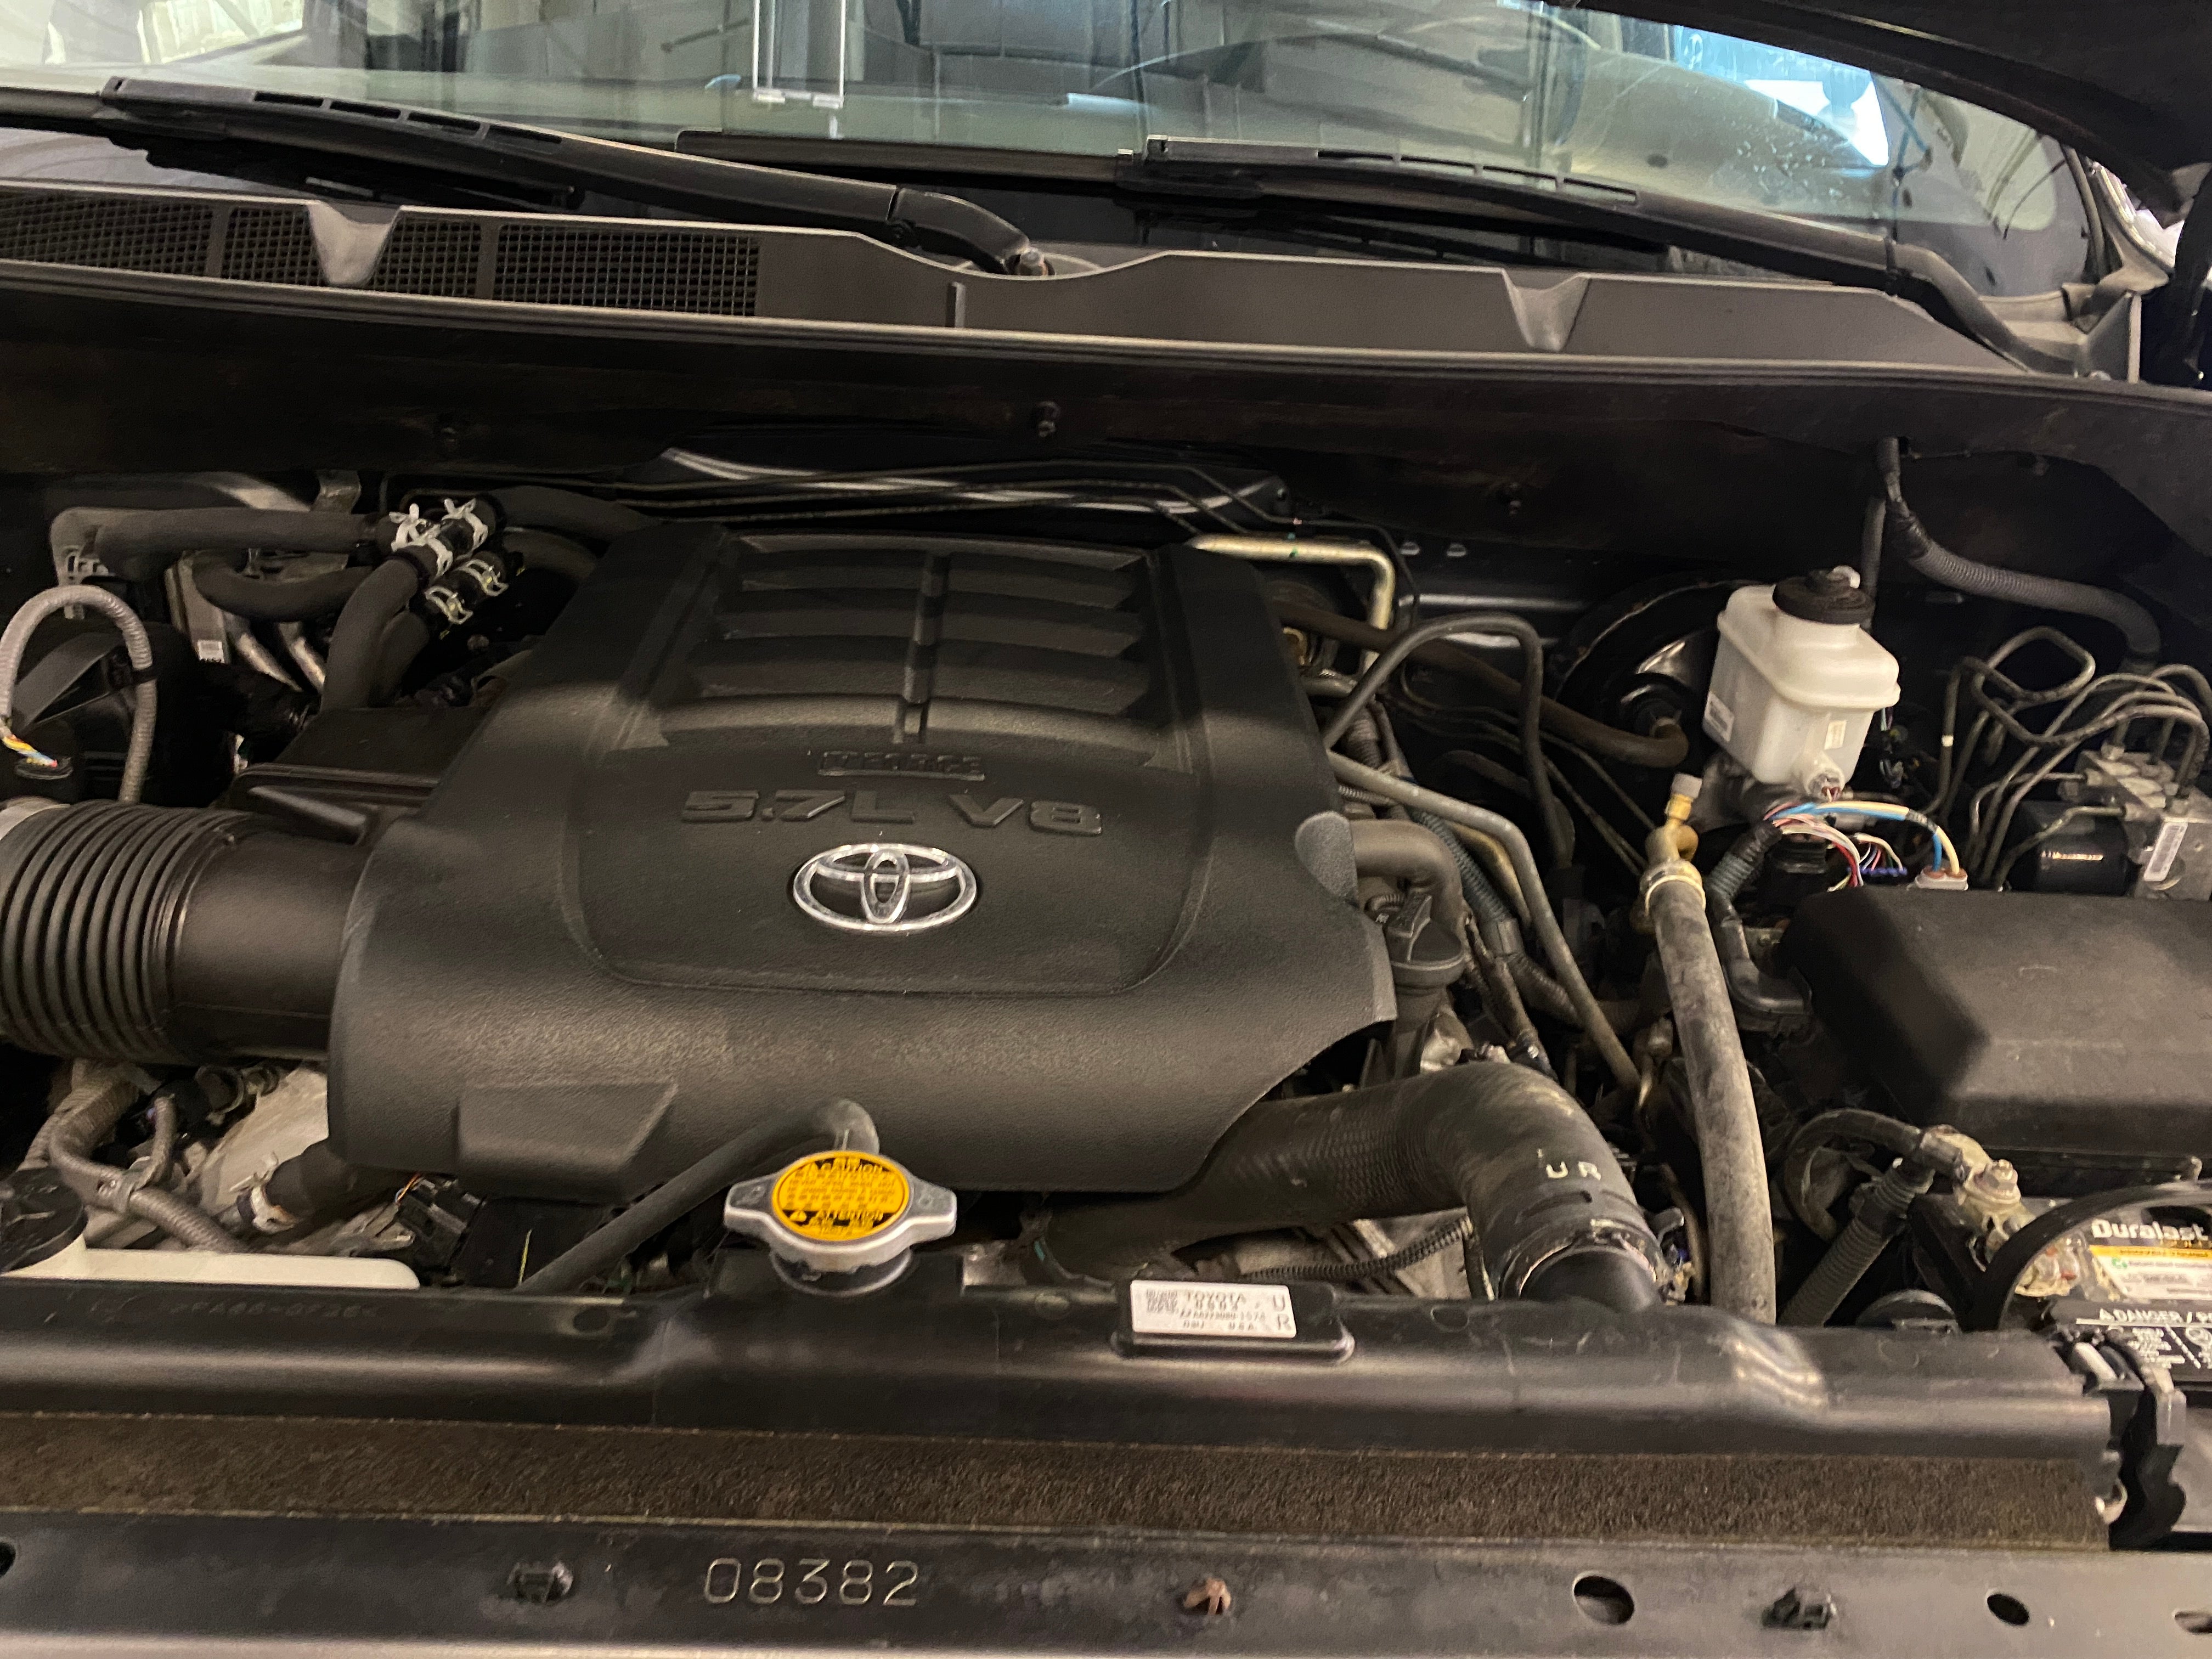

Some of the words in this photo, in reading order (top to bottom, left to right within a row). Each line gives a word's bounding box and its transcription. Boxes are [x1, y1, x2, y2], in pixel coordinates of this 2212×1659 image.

[681, 789, 915, 825] 5.7L
[947, 793, 1103, 836] V8
[2091, 1218, 2209, 1241] Duralast
[1187, 1291, 1248, 1304] TOYOTA
[703, 1557, 919, 1607] 08382
